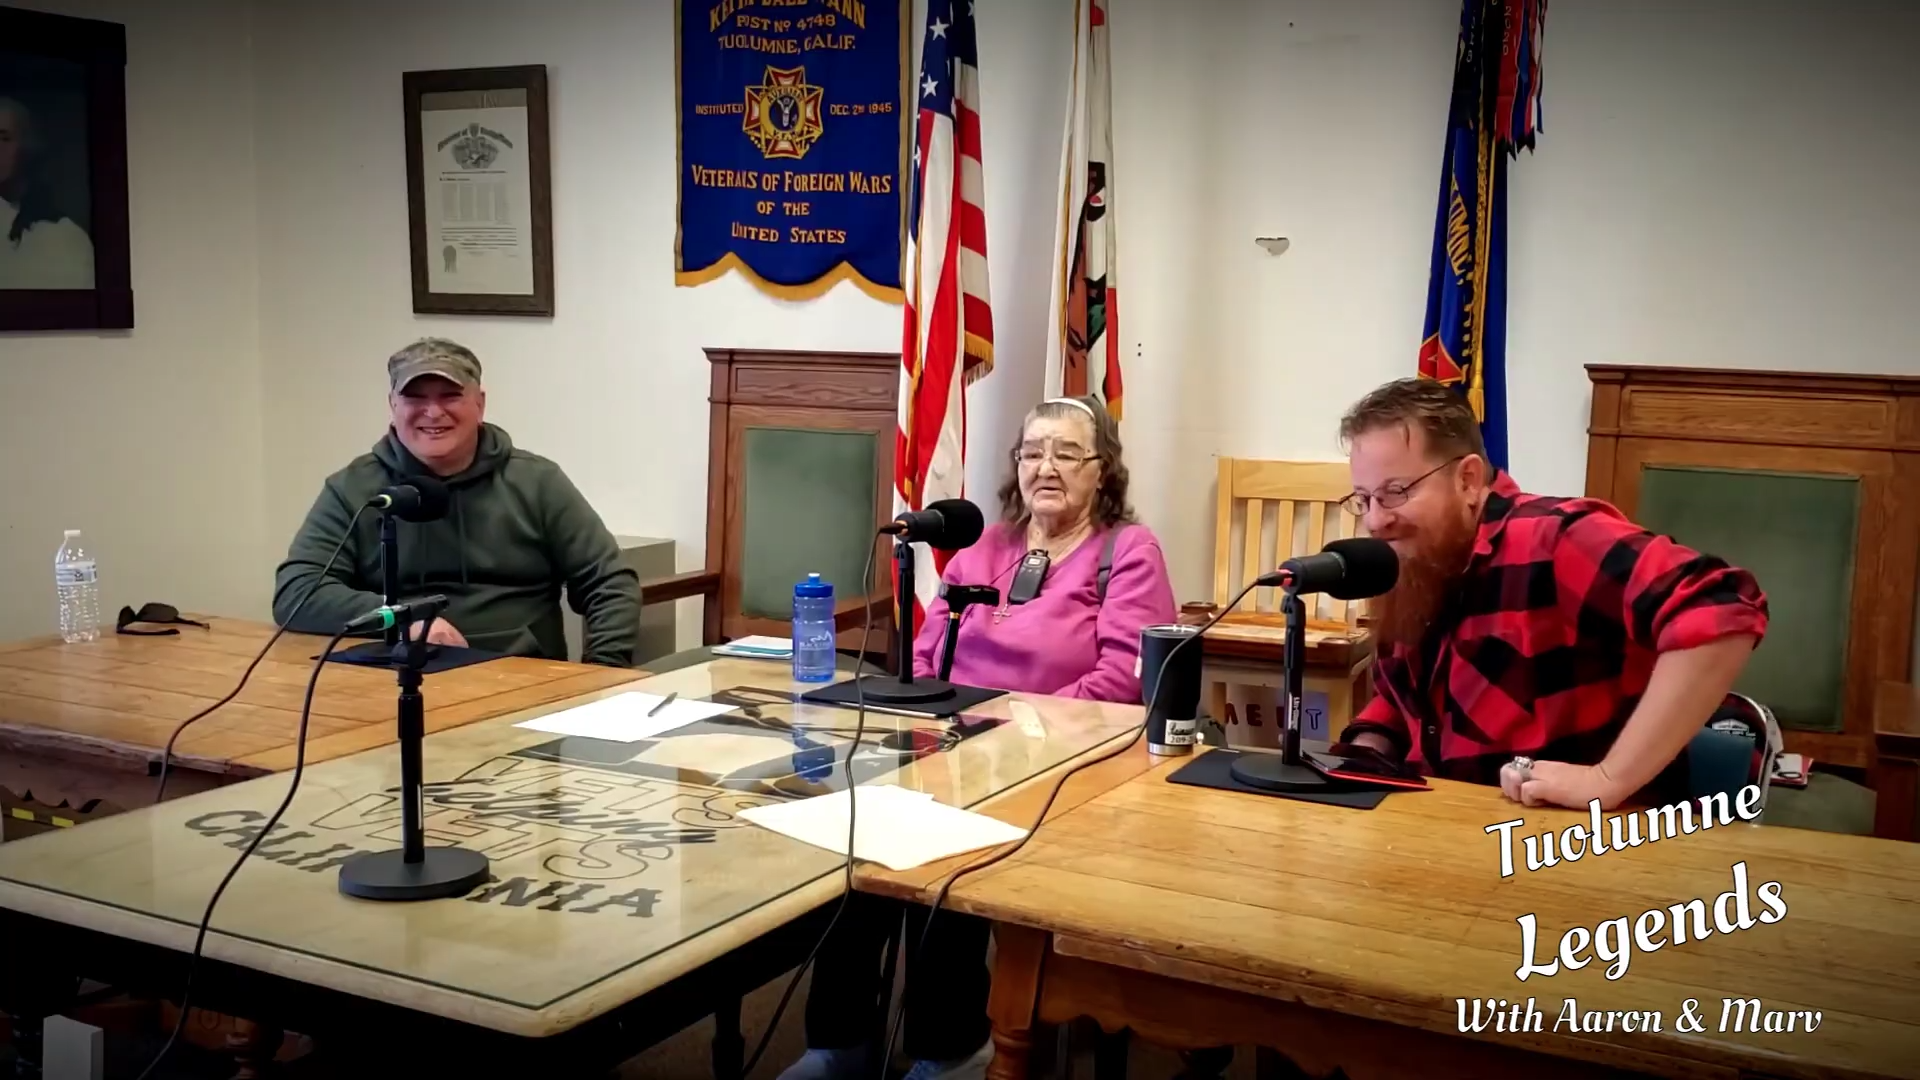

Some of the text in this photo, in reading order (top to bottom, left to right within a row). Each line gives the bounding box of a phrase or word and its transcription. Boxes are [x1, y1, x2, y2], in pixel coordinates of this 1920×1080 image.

[796, 14, 836, 31] 4748
[868, 102, 892, 115] 1945
[762, 174, 780, 192] OF
[784, 171, 844, 192] FOREIGN
[850, 171, 892, 194] WARS
[756, 201, 810, 216] OF THE
[790, 227, 847, 244] STATES
[184, 810, 663, 919] CALINIA
